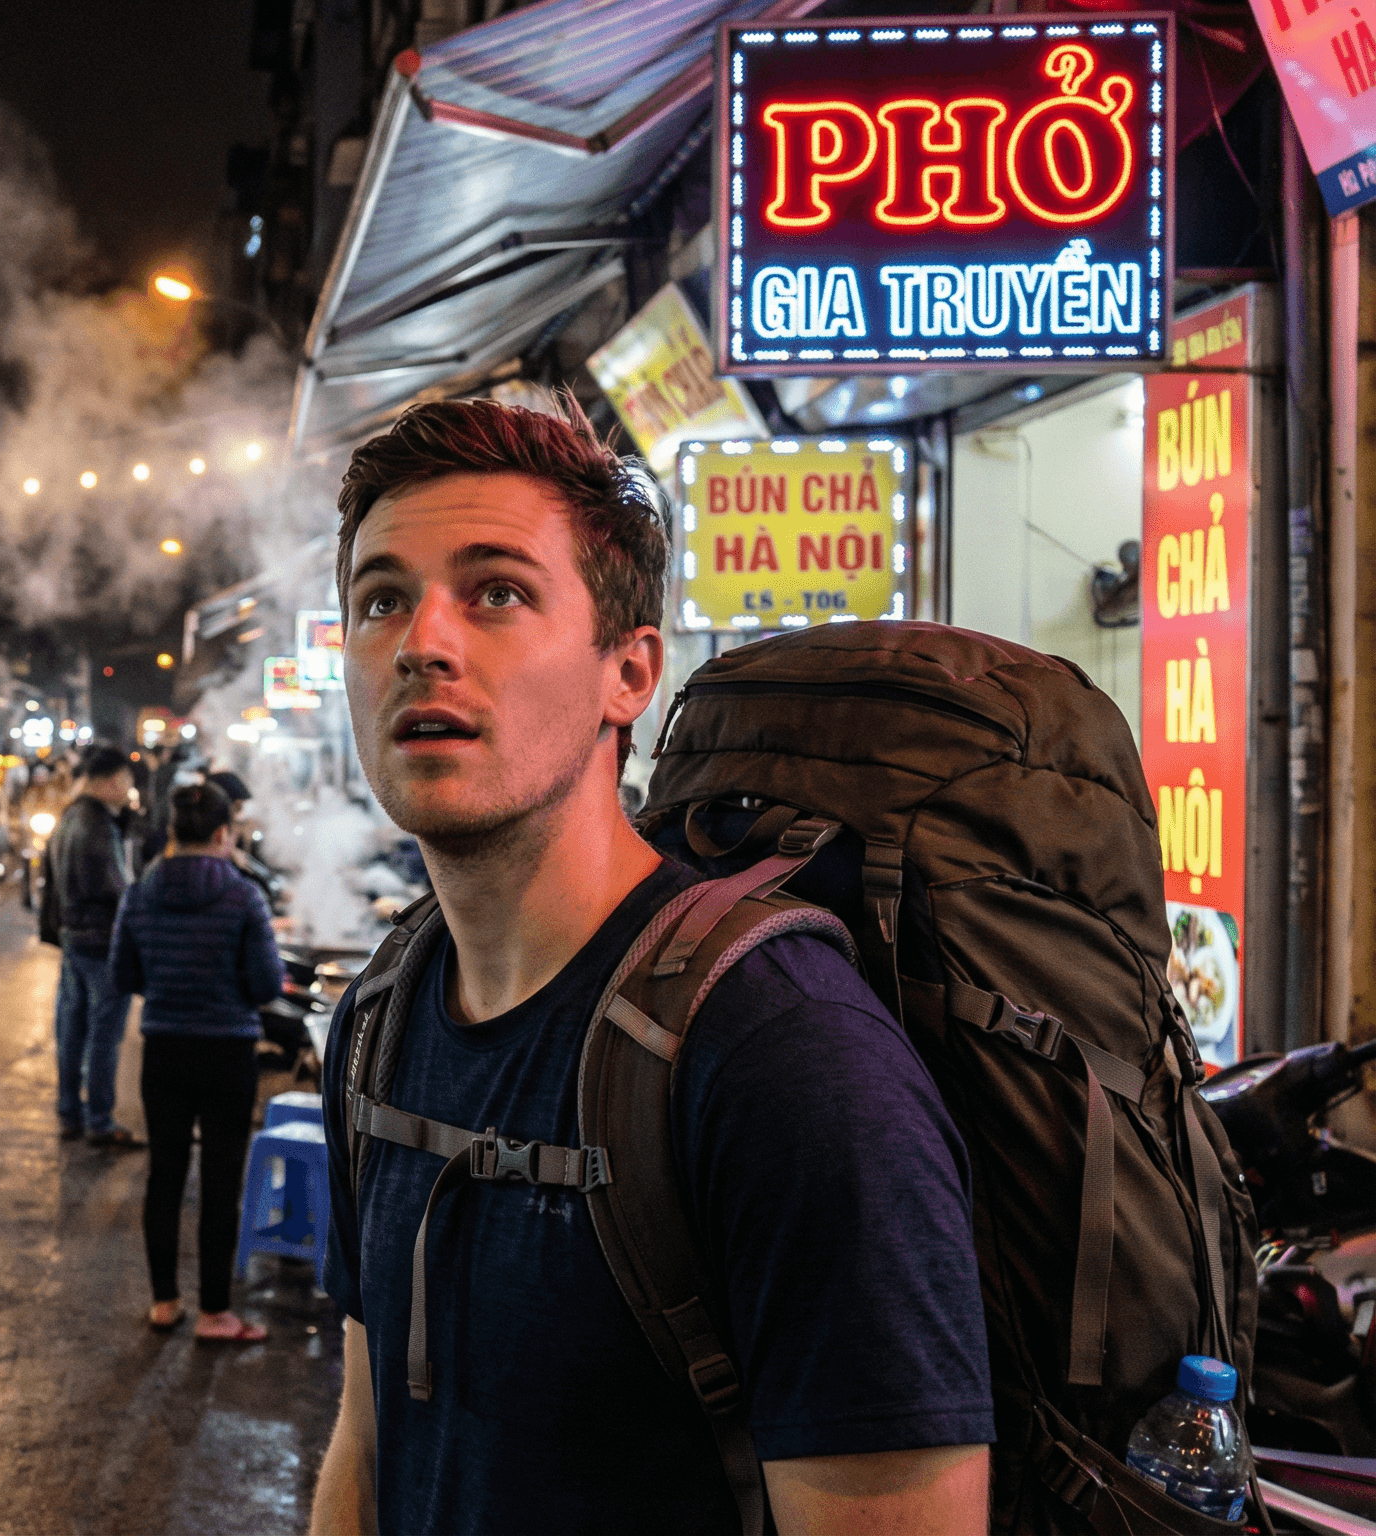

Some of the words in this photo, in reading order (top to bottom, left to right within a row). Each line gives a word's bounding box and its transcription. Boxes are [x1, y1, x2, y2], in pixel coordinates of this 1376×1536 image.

[763, 44, 1134, 227] PHỞ
[752, 266, 866, 338] GIA
[709, 465, 787, 514] BÚN
[802, 456, 880, 513] CHẢ
[1158, 380, 1232, 491] BÚN
[715, 525, 780, 574] HÀ
[798, 524, 885, 582] NỘI
[1157, 493, 1231, 619] CHẢ
[1165, 637, 1217, 744] HÀ
[1159, 768, 1222, 895] NỘI
